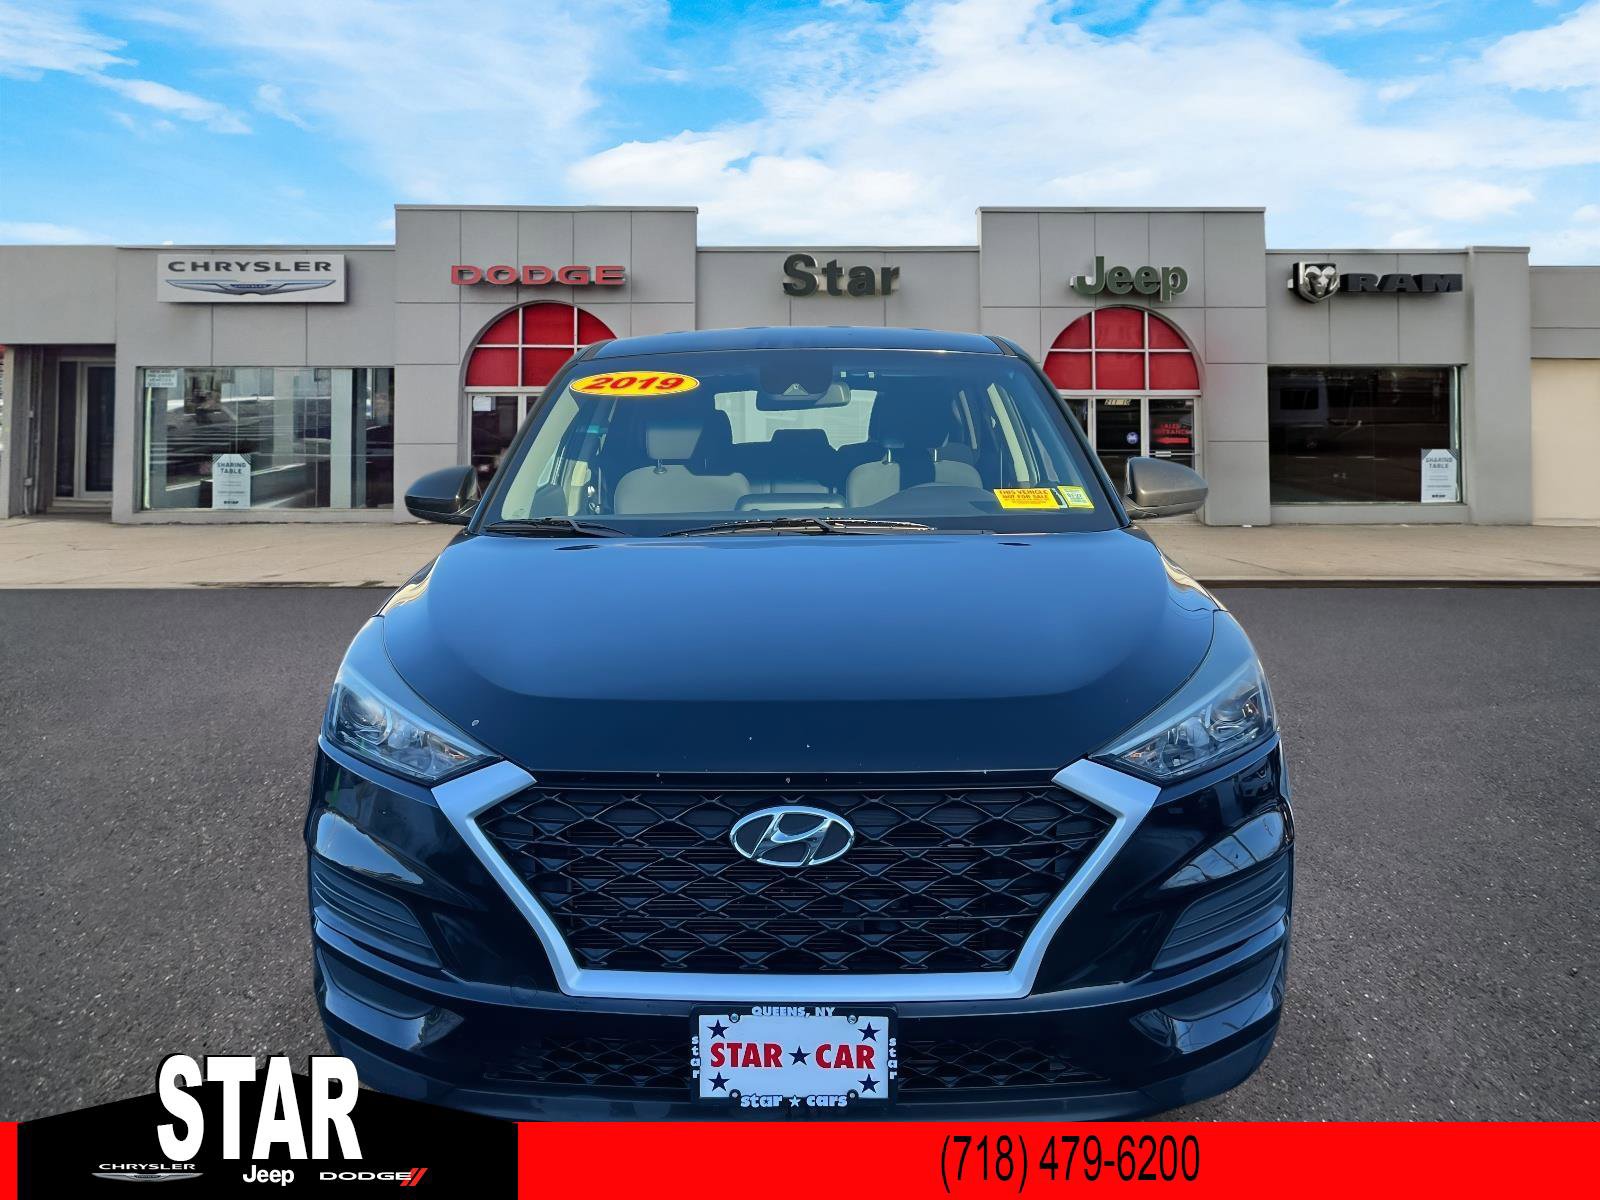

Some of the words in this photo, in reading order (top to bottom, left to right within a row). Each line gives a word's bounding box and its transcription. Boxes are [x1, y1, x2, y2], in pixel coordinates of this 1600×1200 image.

[168, 261, 331, 272] CHRYSLER
[451, 265, 626, 286] DODGE
[783, 253, 900, 297] Star
[1073, 256, 1189, 302] Jeep
[1341, 273, 1463, 293] RAM
[582, 376, 685, 390] 2019
[751, 1006, 811, 1018] QUEENS,
[815, 1007, 836, 1017] NY
[690, 1036, 701, 1079] star
[710, 1042, 783, 1068] STAR
[815, 1043, 876, 1070] CAR
[888, 1037, 898, 1080] star
[740, 1093, 783, 1108] star
[806, 1095, 848, 1107] cars
